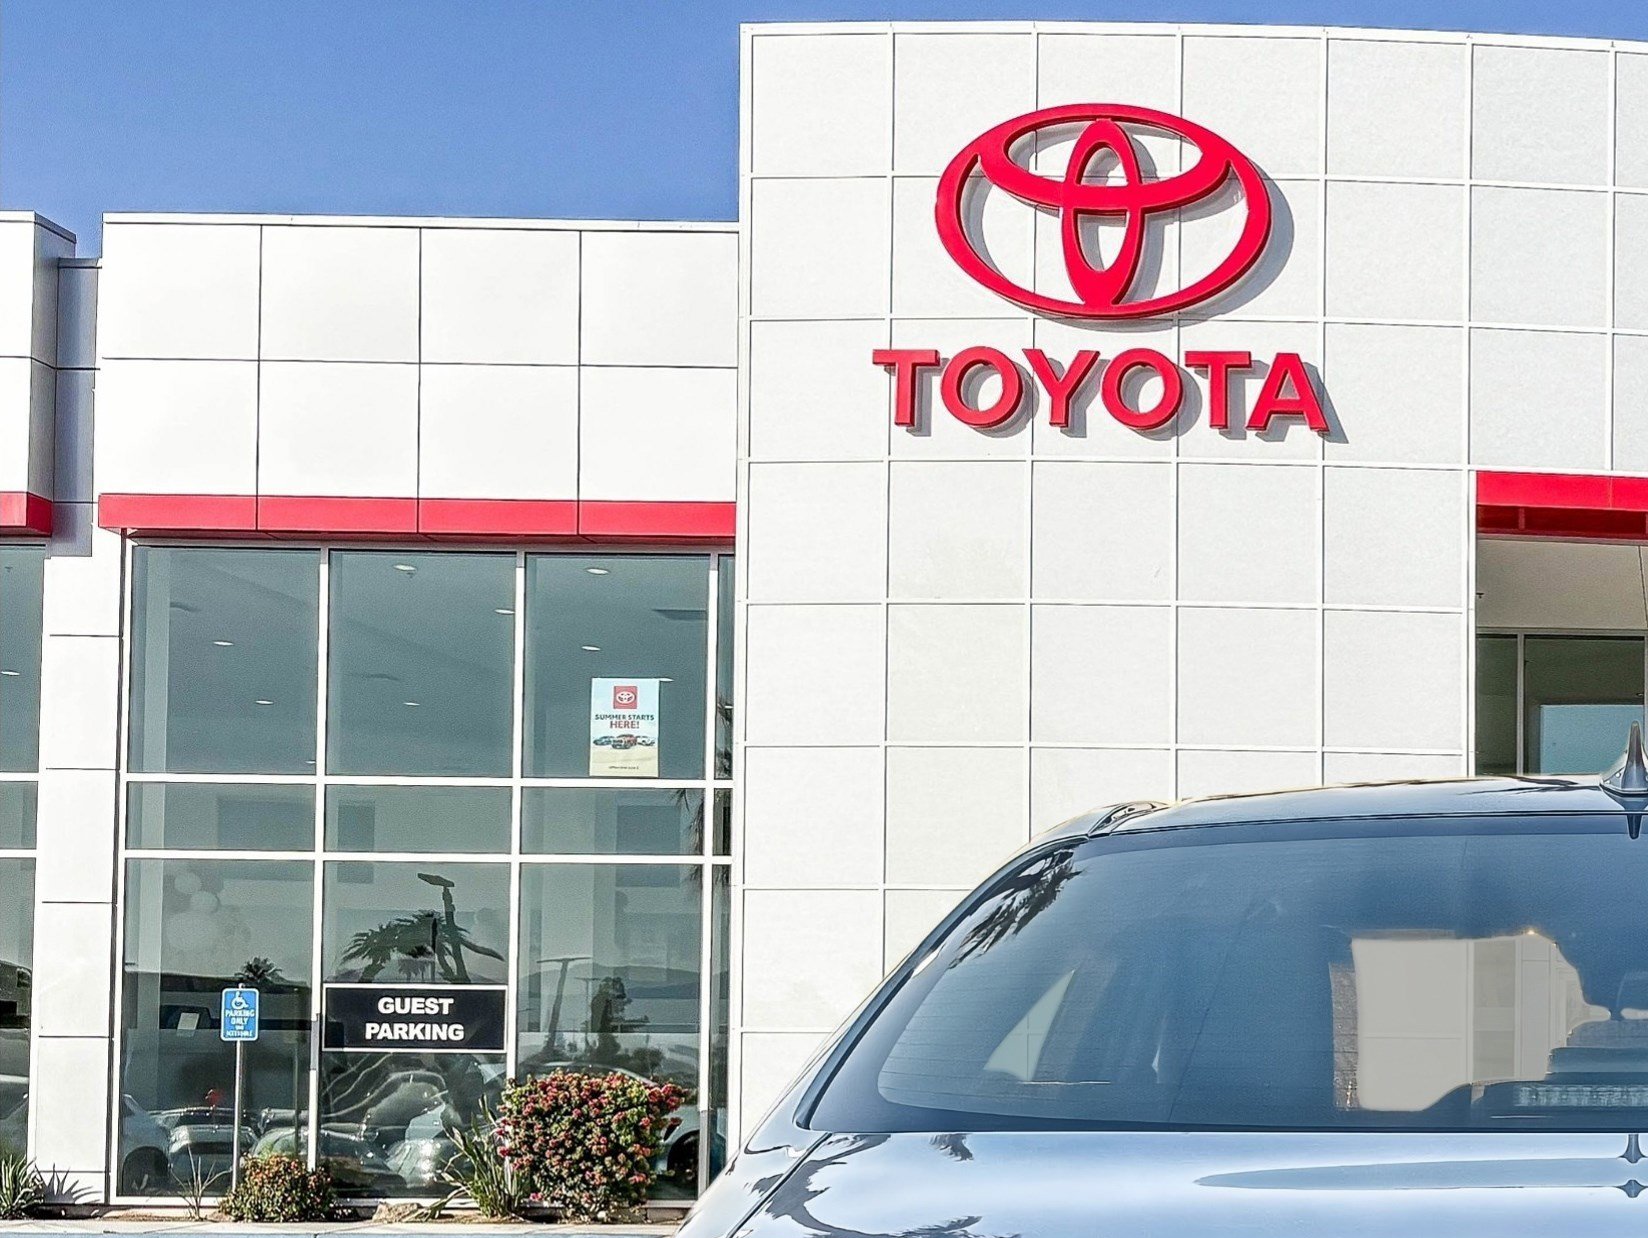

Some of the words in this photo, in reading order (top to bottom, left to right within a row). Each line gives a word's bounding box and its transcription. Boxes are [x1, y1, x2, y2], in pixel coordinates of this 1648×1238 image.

[873, 346, 1329, 434] TOYOTA
[610, 721, 640, 729] HERE!
[377, 997, 454, 1015] GUEST
[225, 1009, 255, 1018] PARKING
[231, 1016, 249, 1025] ONLY
[365, 1023, 465, 1041] PARKING
